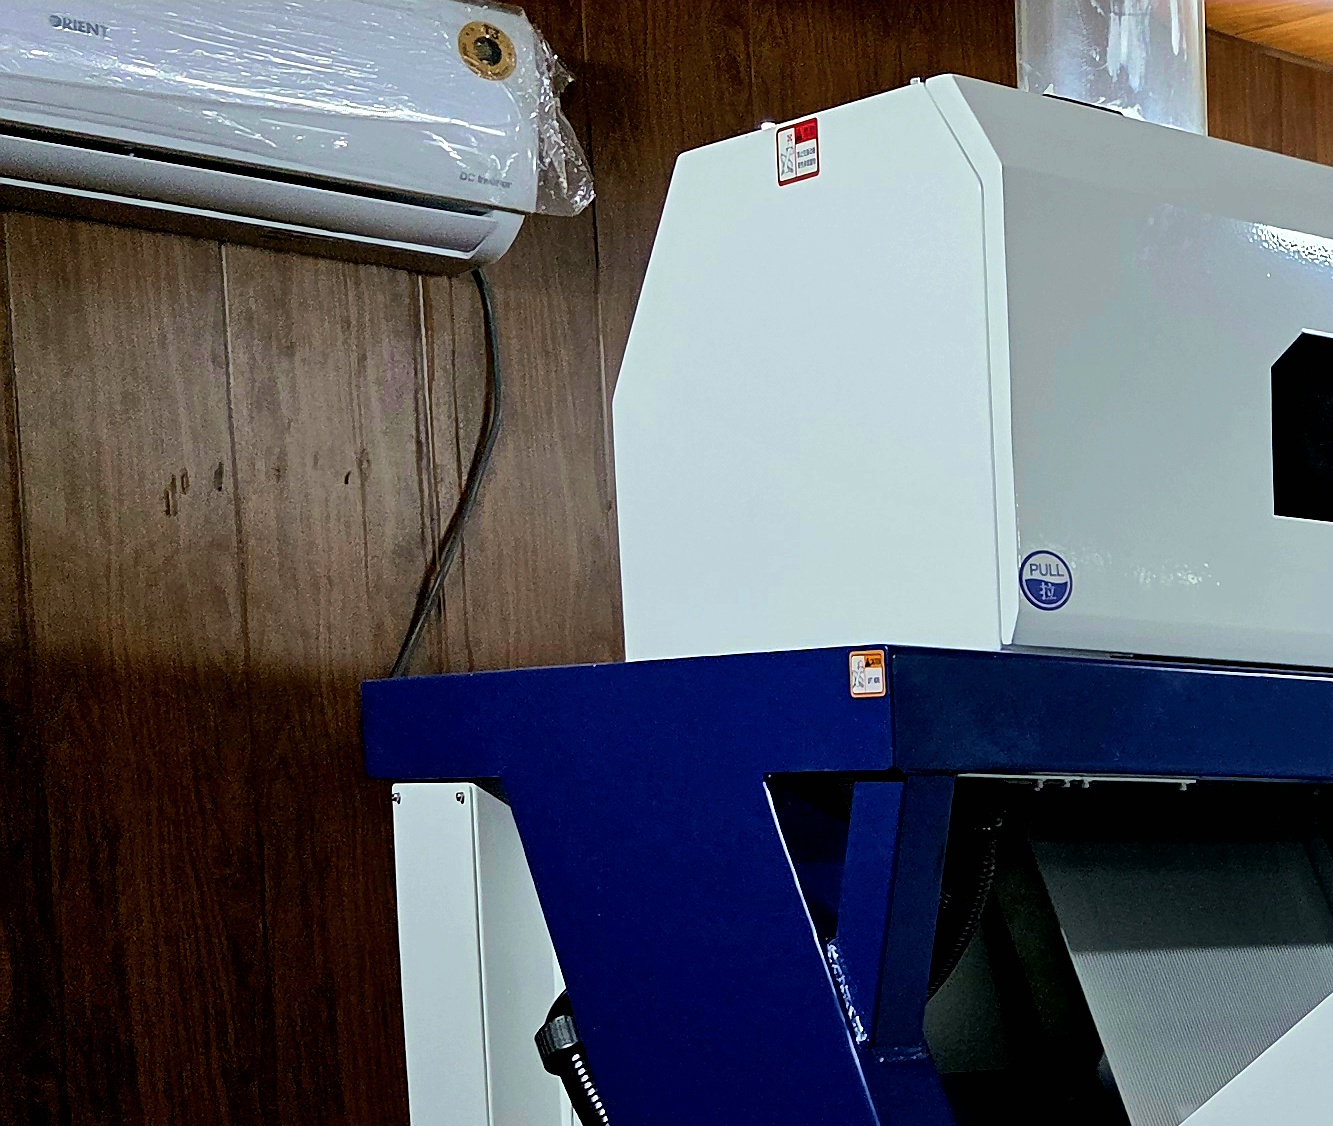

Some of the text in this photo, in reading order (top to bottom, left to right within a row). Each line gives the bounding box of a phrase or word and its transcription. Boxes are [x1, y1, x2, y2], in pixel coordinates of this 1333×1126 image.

[49, 14, 110, 37] ORIENT
[1030, 563, 1065, 577] PULL
[1039, 581, 1057, 600] 拉
